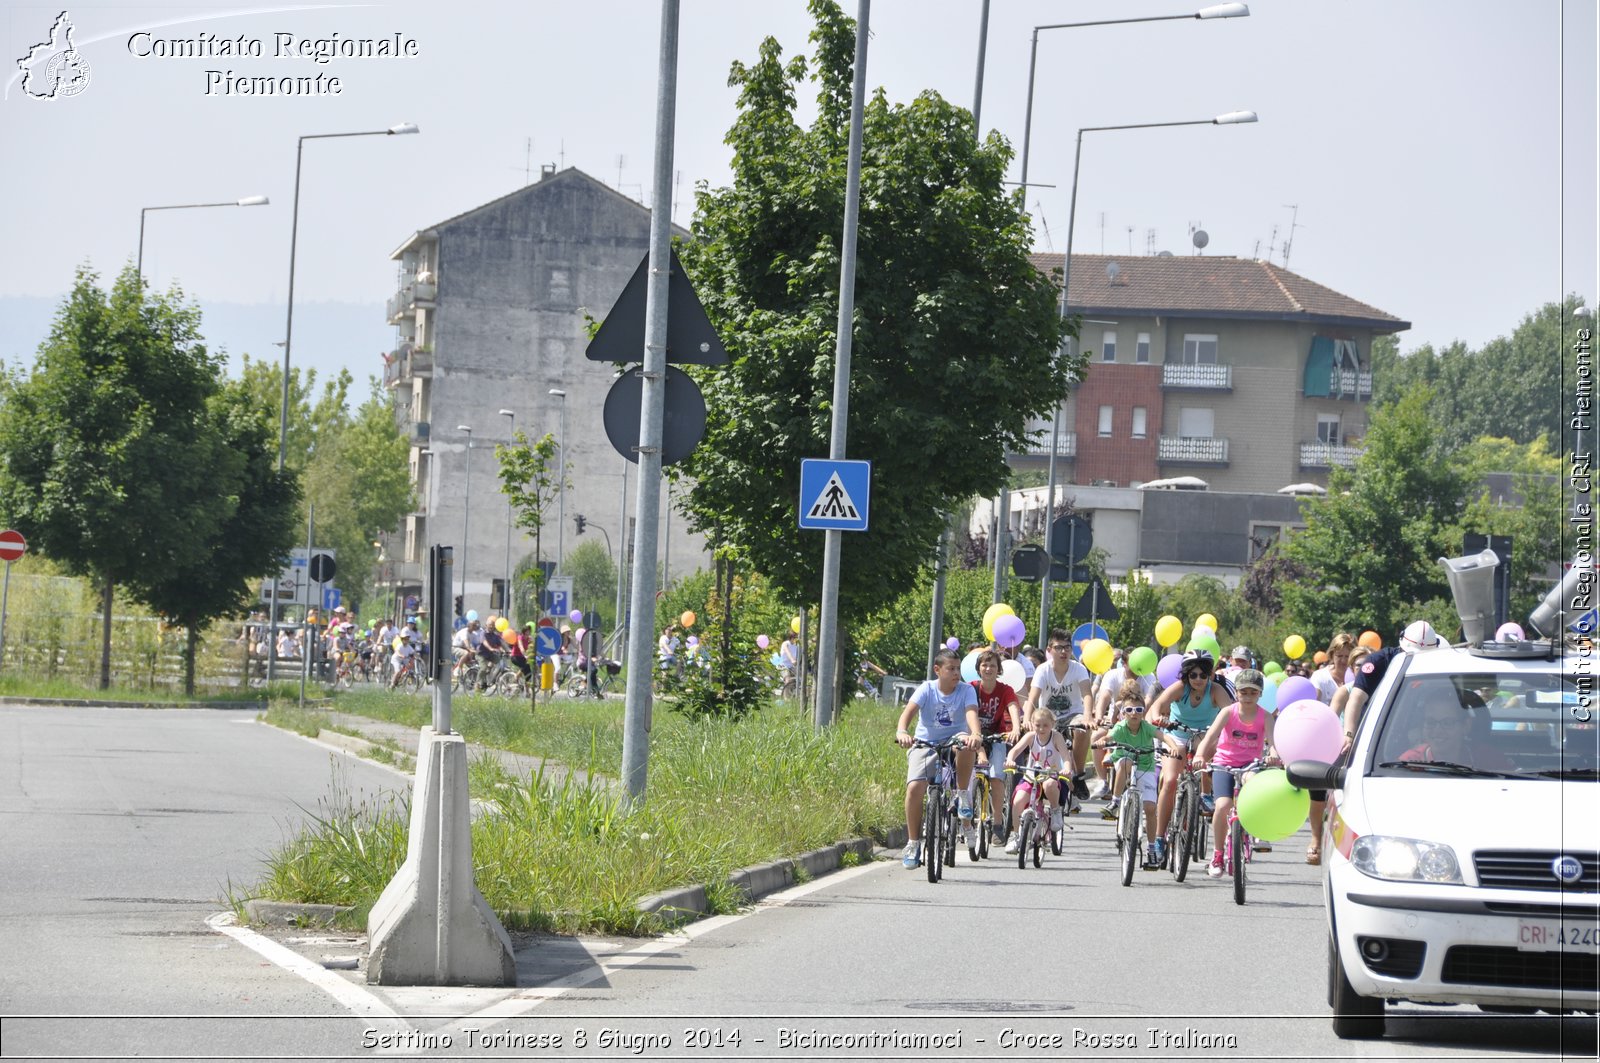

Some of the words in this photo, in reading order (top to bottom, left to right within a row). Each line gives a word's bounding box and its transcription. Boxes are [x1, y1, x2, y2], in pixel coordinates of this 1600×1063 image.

[553, 592, 564, 605] P
[1051, 683, 1073, 696] WANT
[1560, 864, 1577, 874] FIAT
